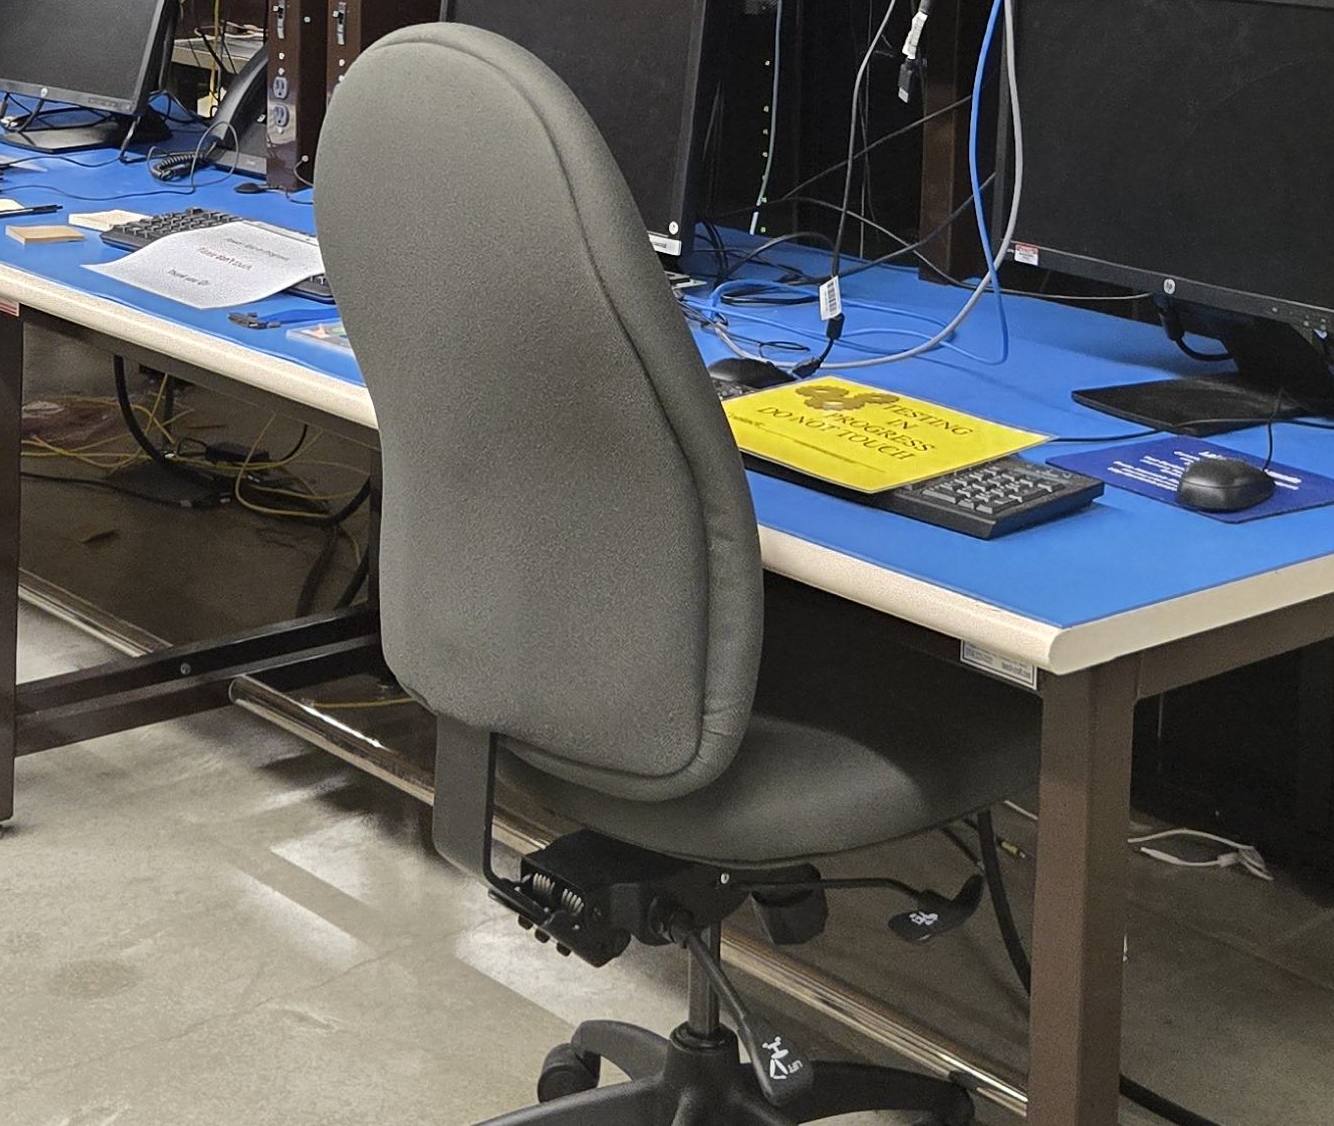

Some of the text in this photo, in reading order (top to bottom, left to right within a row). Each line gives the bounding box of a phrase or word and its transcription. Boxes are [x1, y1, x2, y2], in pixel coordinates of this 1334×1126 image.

[757, 406, 915, 461] DO NOT TOUCH
[824, 410, 937, 454] PROGRESS
[883, 403, 974, 436] TESTING
[885, 417, 918, 432] IN
[787, 1059, 804, 1074] LIFT
